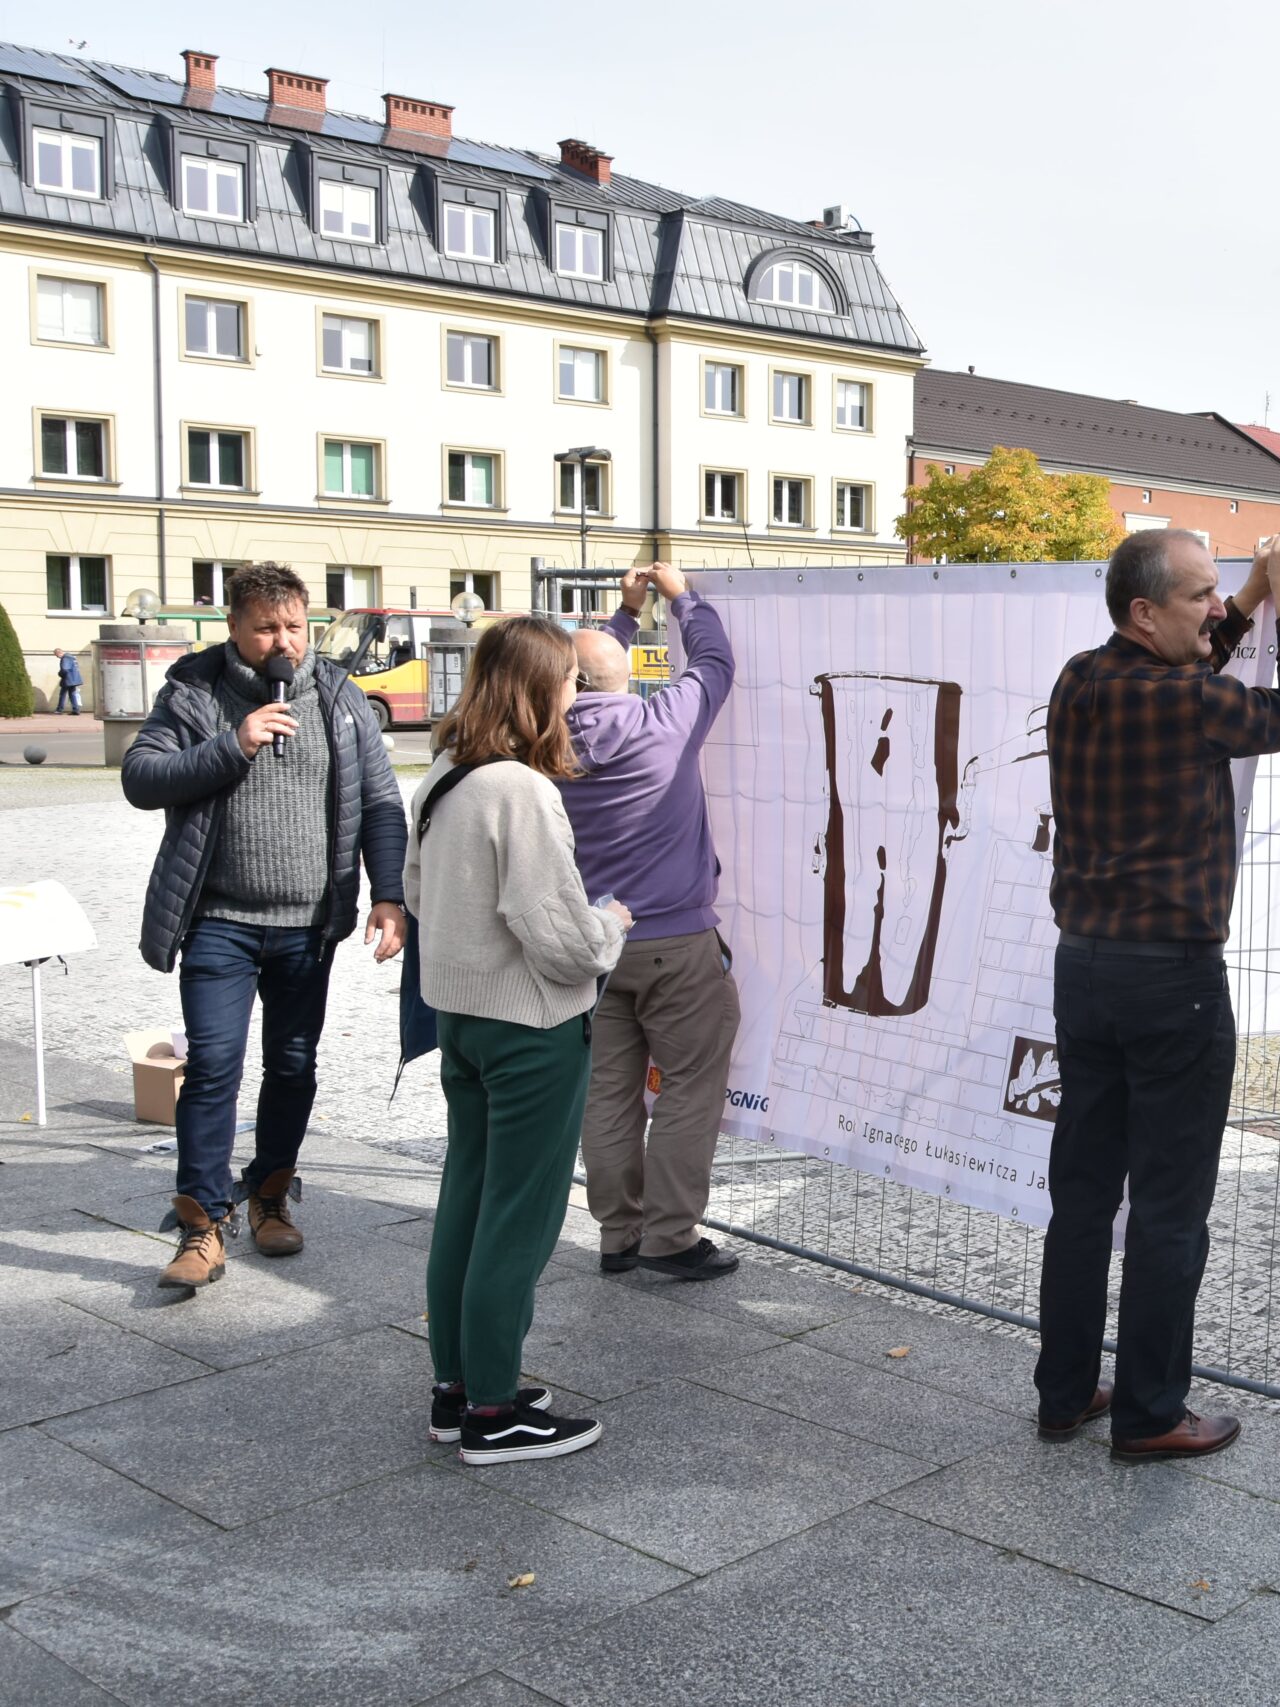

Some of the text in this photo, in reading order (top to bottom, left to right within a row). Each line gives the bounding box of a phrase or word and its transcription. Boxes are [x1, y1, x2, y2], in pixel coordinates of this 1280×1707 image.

[863, 1121, 918, 1154] Ignacego
[926, 1140, 1017, 1183] Łukasiewicza
[1026, 1170, 1052, 1192] Ja
